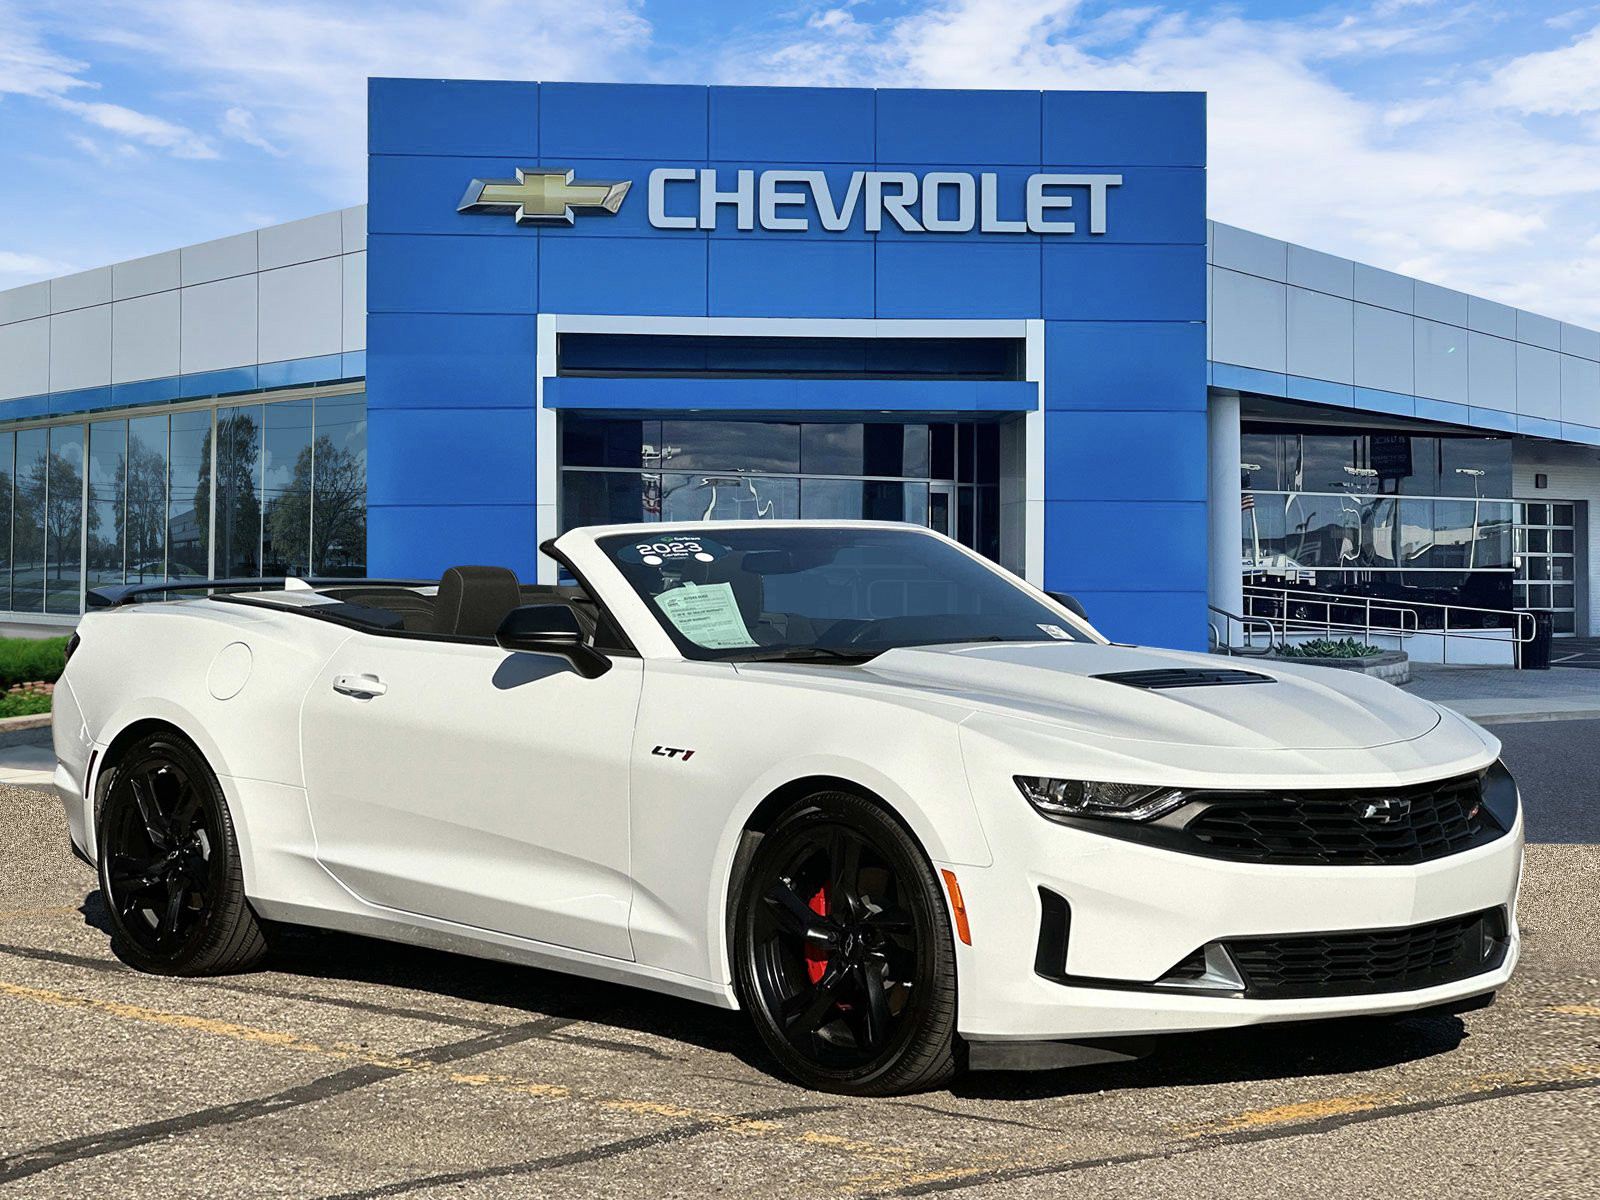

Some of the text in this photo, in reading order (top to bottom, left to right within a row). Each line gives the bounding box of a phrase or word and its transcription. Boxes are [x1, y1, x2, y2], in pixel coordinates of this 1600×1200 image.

[647, 167, 1123, 235] CHEVROLET
[636, 542, 703, 554] 2023
[651, 745, 696, 762] LT1
